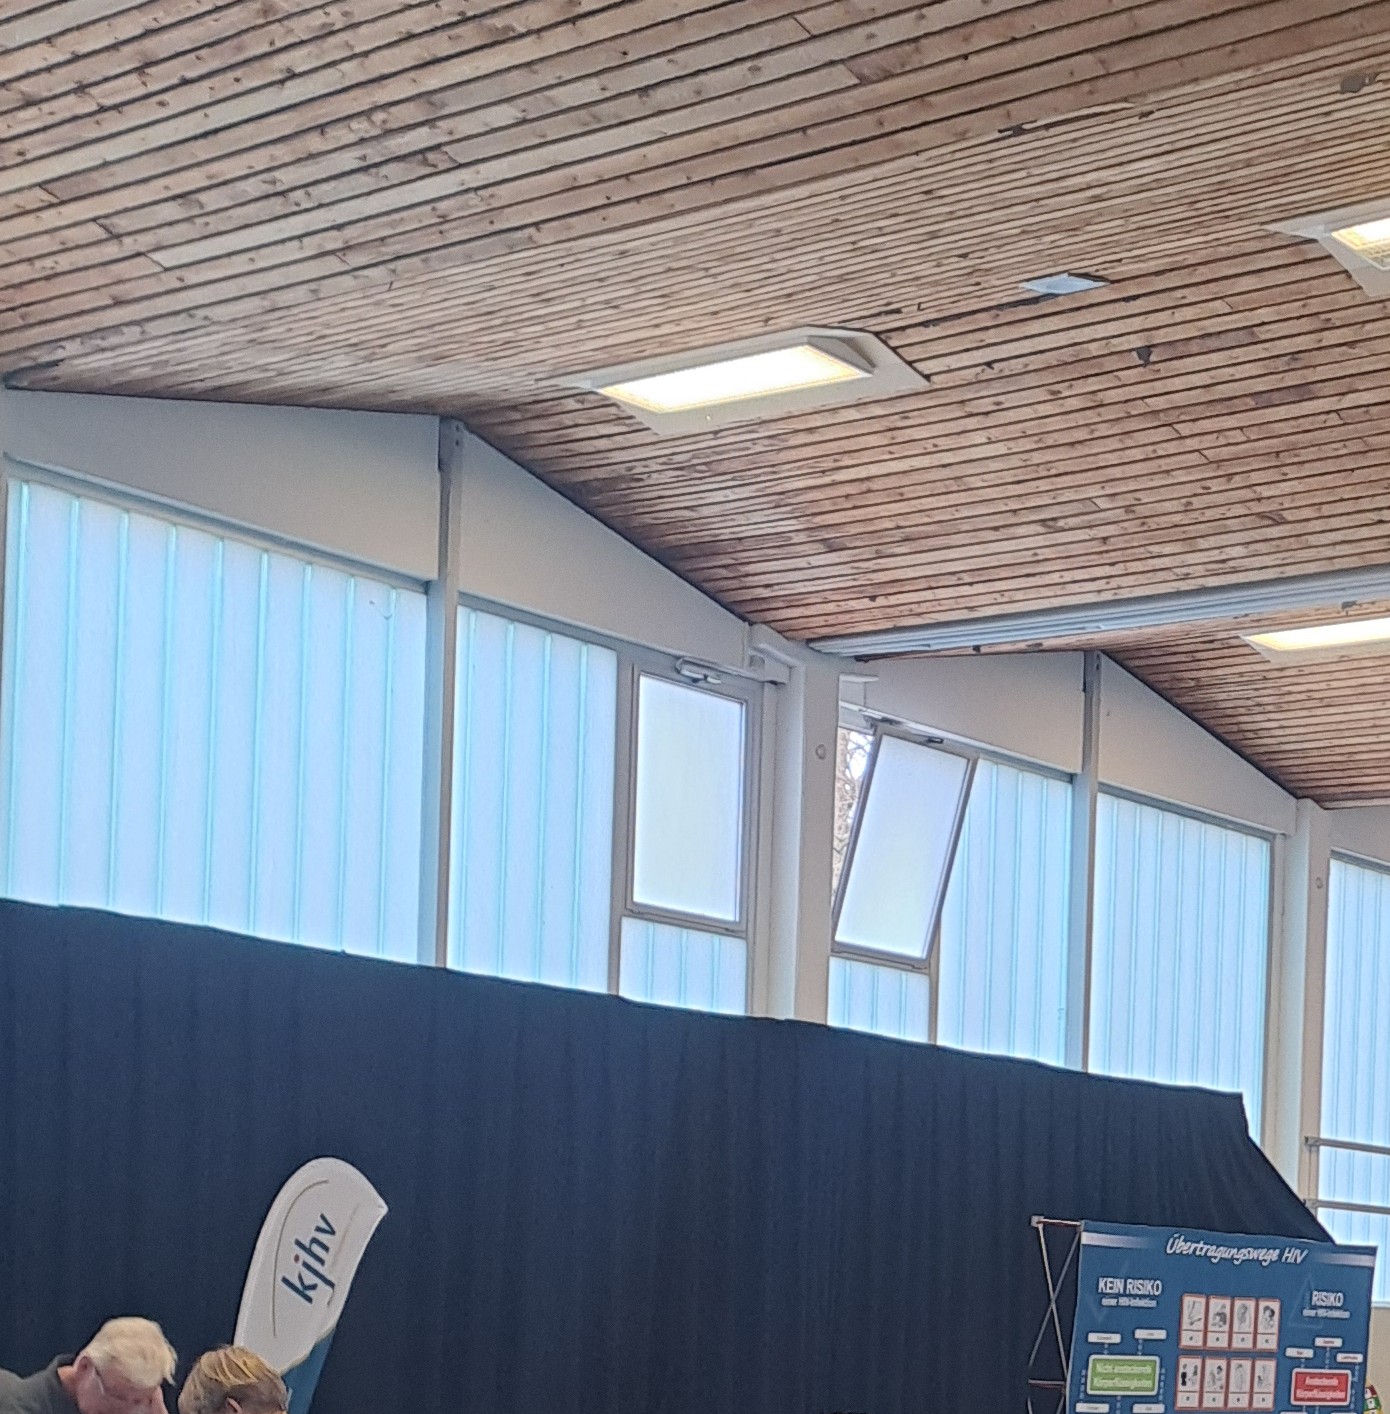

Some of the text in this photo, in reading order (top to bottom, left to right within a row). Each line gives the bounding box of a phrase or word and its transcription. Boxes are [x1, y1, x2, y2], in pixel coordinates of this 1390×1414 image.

[281, 1213, 336, 1307] kjhv
[1166, 1232, 1308, 1266] Übertragungswege HIV
[1098, 1277, 1163, 1296] KEIN RISIKO
[1312, 1290, 1344, 1307] RISIKO
